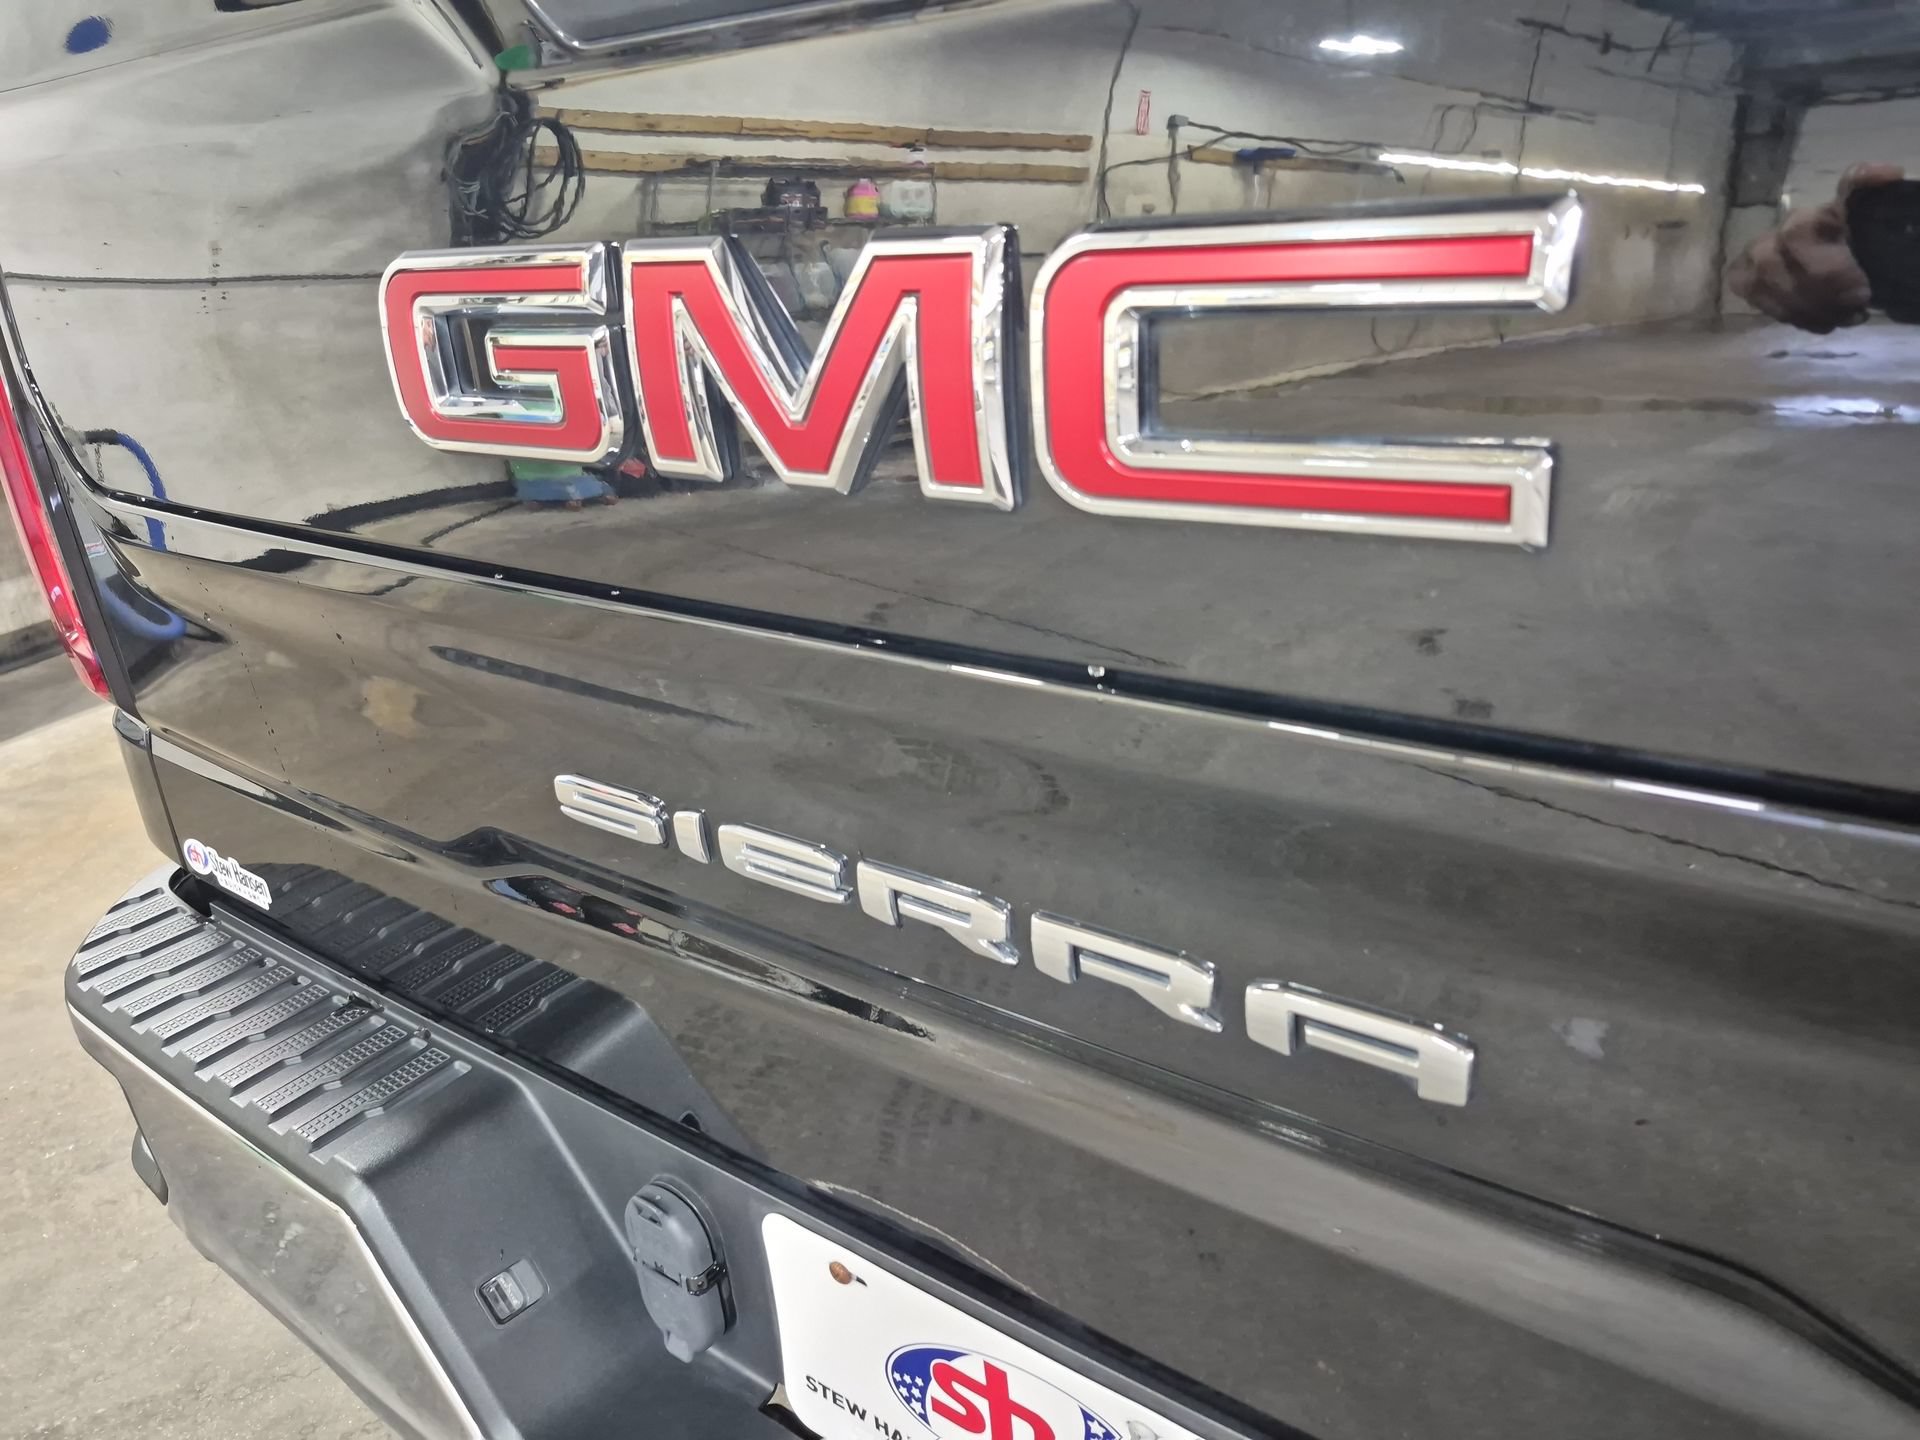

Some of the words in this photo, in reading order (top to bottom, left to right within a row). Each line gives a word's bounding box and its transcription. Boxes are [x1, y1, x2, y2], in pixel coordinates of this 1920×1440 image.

[377, 190, 1586, 550] GMC
[208, 850, 233, 879] Stew
[230, 858, 268, 898] Hansen
[553, 772, 1478, 1107] SIERRA
[805, 1375, 867, 1421] STEW
[874, 1416, 911, 1440] HA
